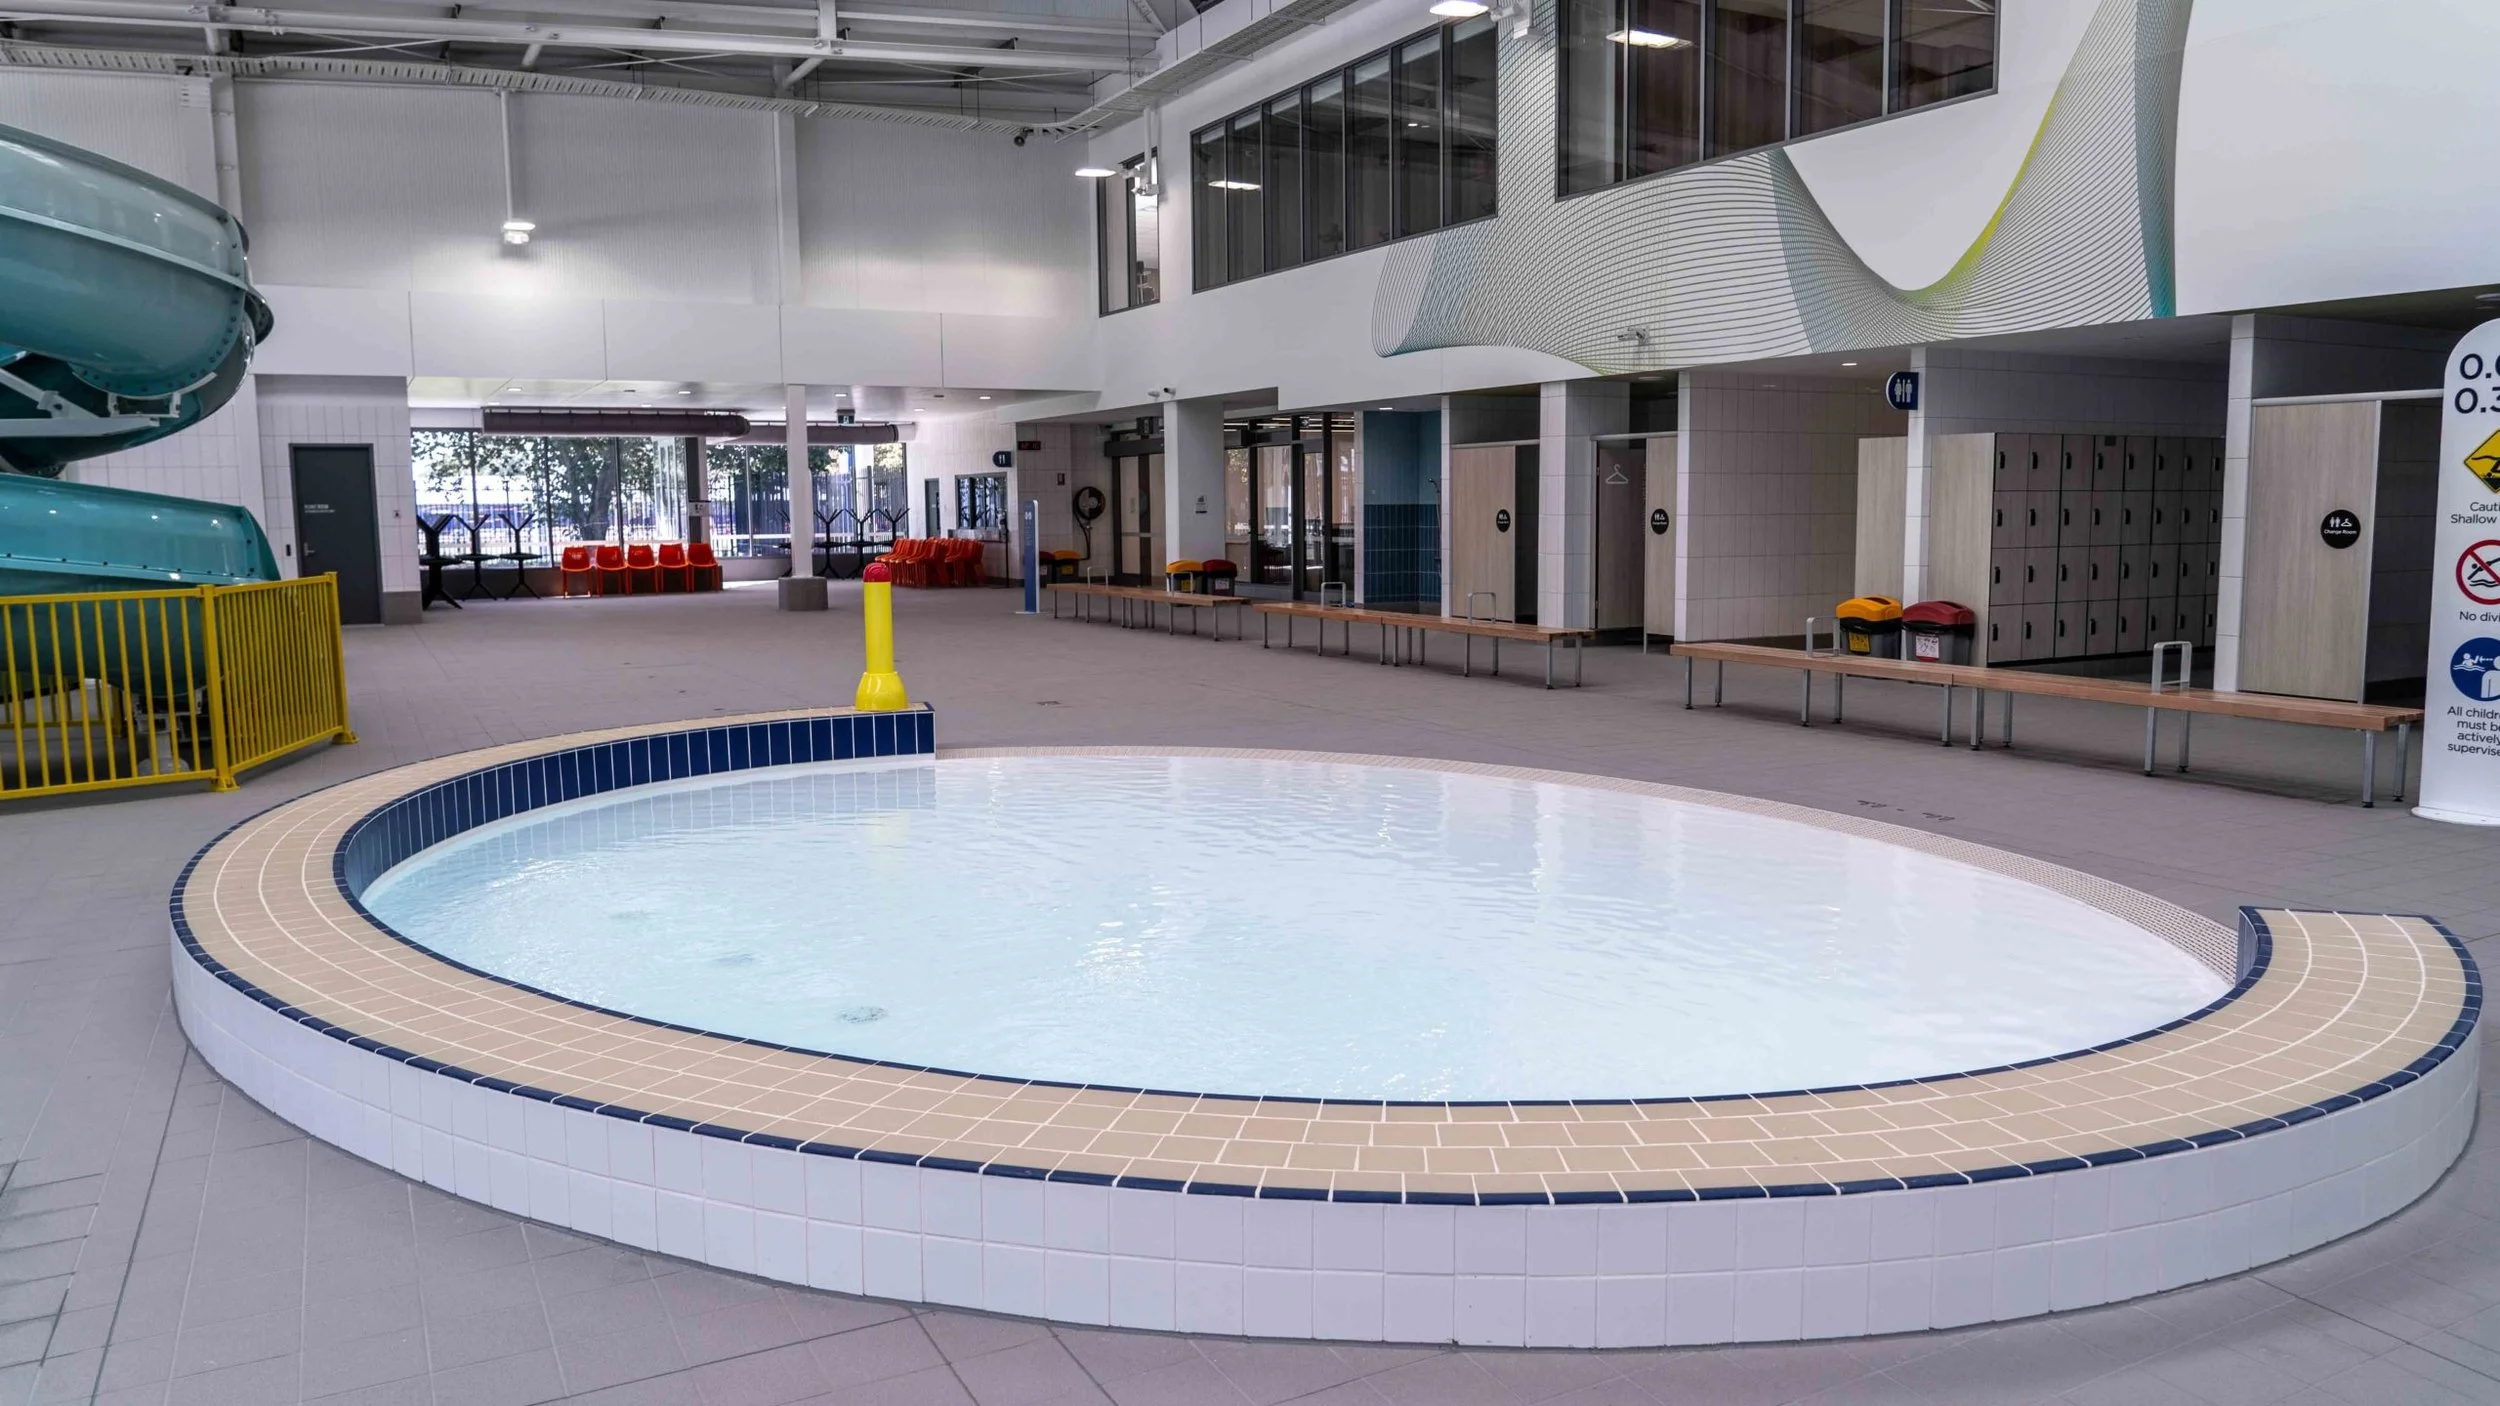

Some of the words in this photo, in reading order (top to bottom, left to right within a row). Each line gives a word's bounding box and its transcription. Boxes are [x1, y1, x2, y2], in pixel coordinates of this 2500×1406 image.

[2459, 353, 2500, 380] 0.
[2450, 513, 2497, 524] Shallow
[2459, 611, 2476, 621] No
[2447, 706, 2463, 716] All
[2465, 707, 2500, 719] childr
[2457, 720, 2487, 731] must
